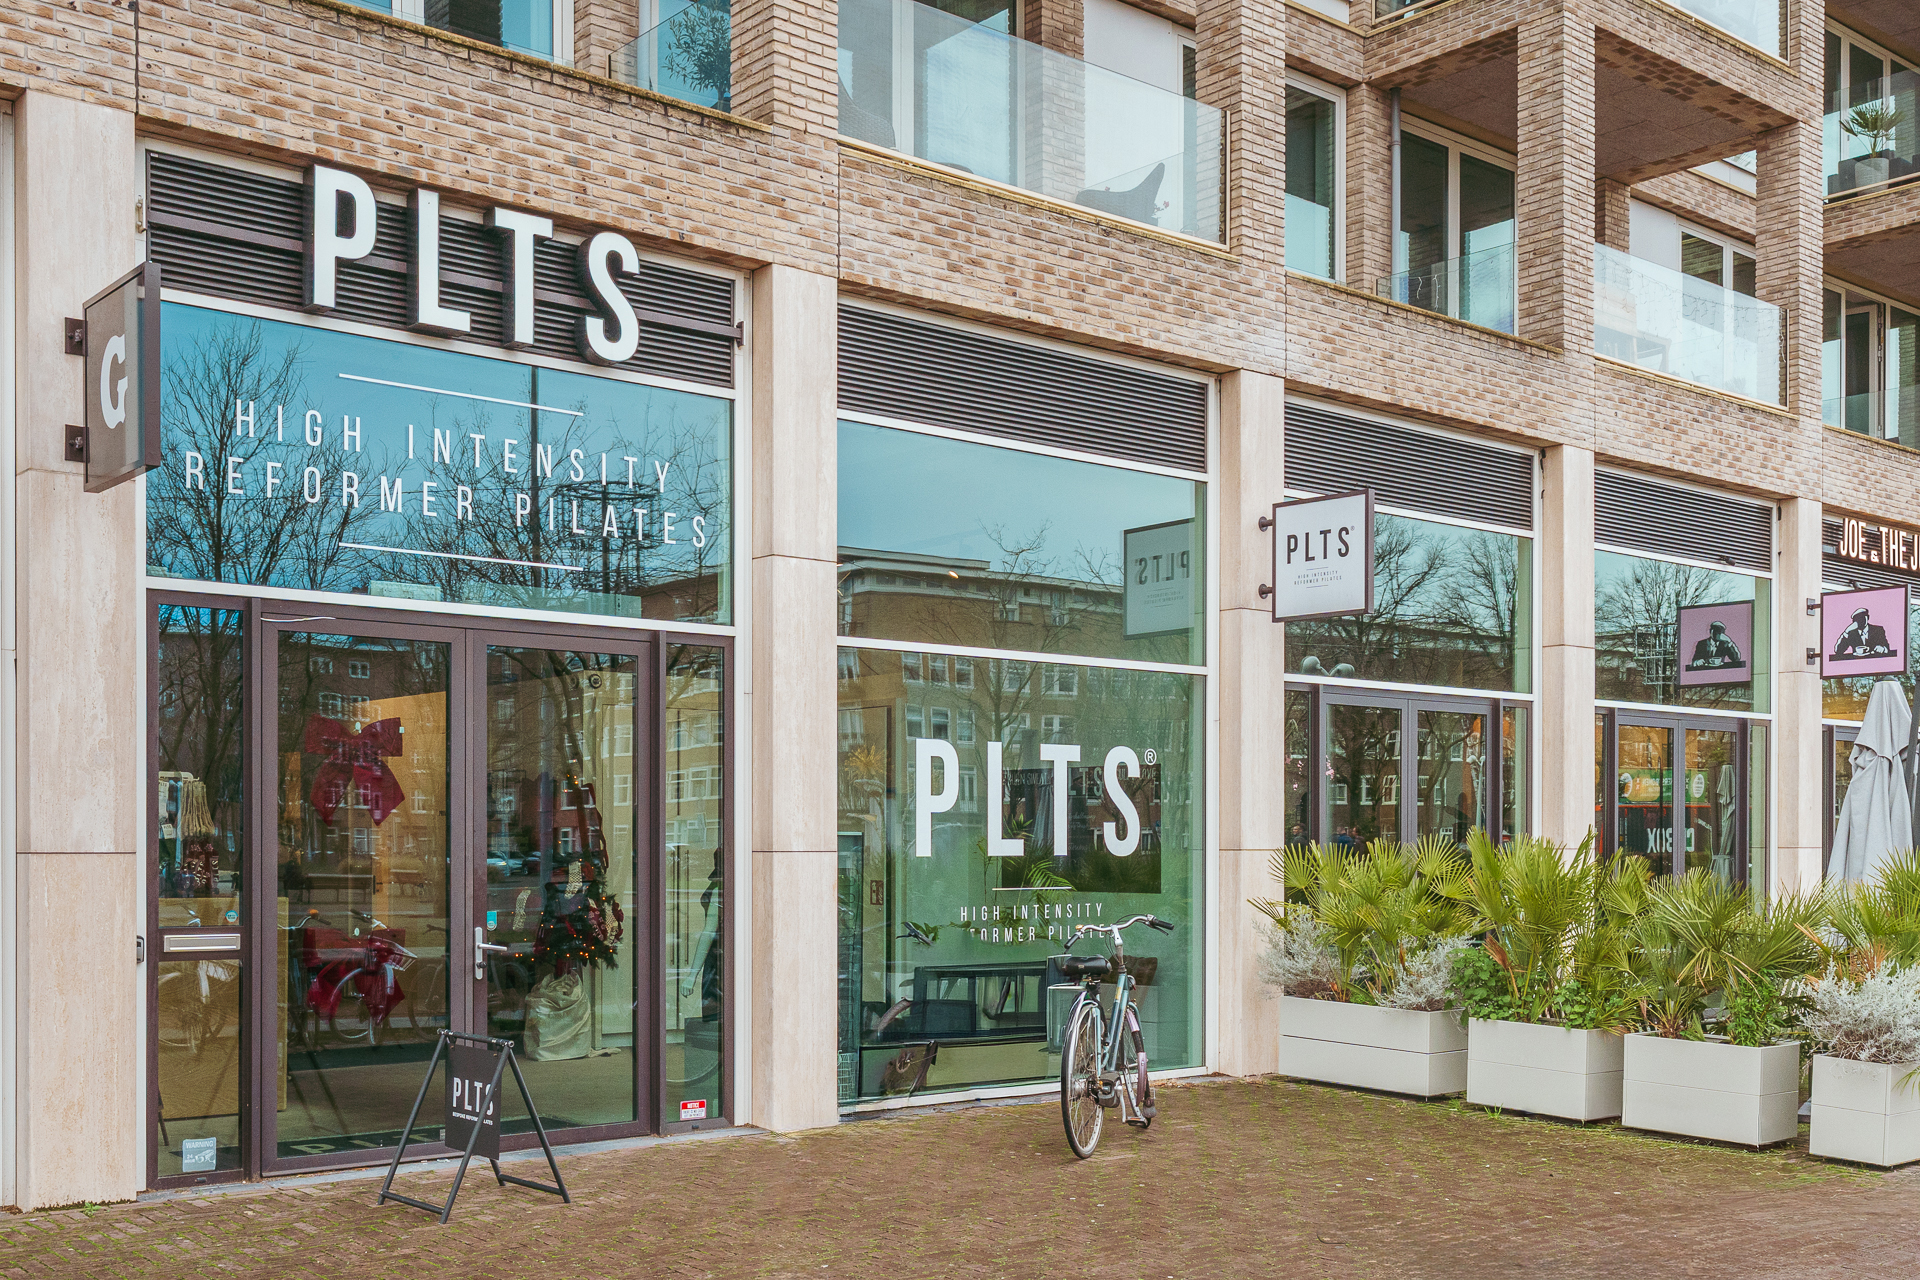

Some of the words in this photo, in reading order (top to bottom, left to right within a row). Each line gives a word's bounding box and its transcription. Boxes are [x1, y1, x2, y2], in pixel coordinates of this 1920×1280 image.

[309, 164, 640, 364] PLTS
[100, 333, 129, 430] G
[235, 398, 362, 454] HIGH
[407, 423, 671, 495] INTENSITY
[185, 450, 474, 521] REFORMER
[515, 492, 707, 549] PILATES
[1840, 517, 1867, 561] JOE
[1870, 550, 1879, 563] &
[1879, 525, 1908, 569] THE
[1911, 534, 1920, 571] J
[1294, 578, 1319, 586] REFORMER
[1321, 575, 1342, 583] PILATES
[1311, 570, 1338, 578] INTENSITY
[959, 905, 1001, 922] HIGH
[1013, 903, 1103, 920] INTENSITY
[185, 1140, 214, 1149] WARNING
